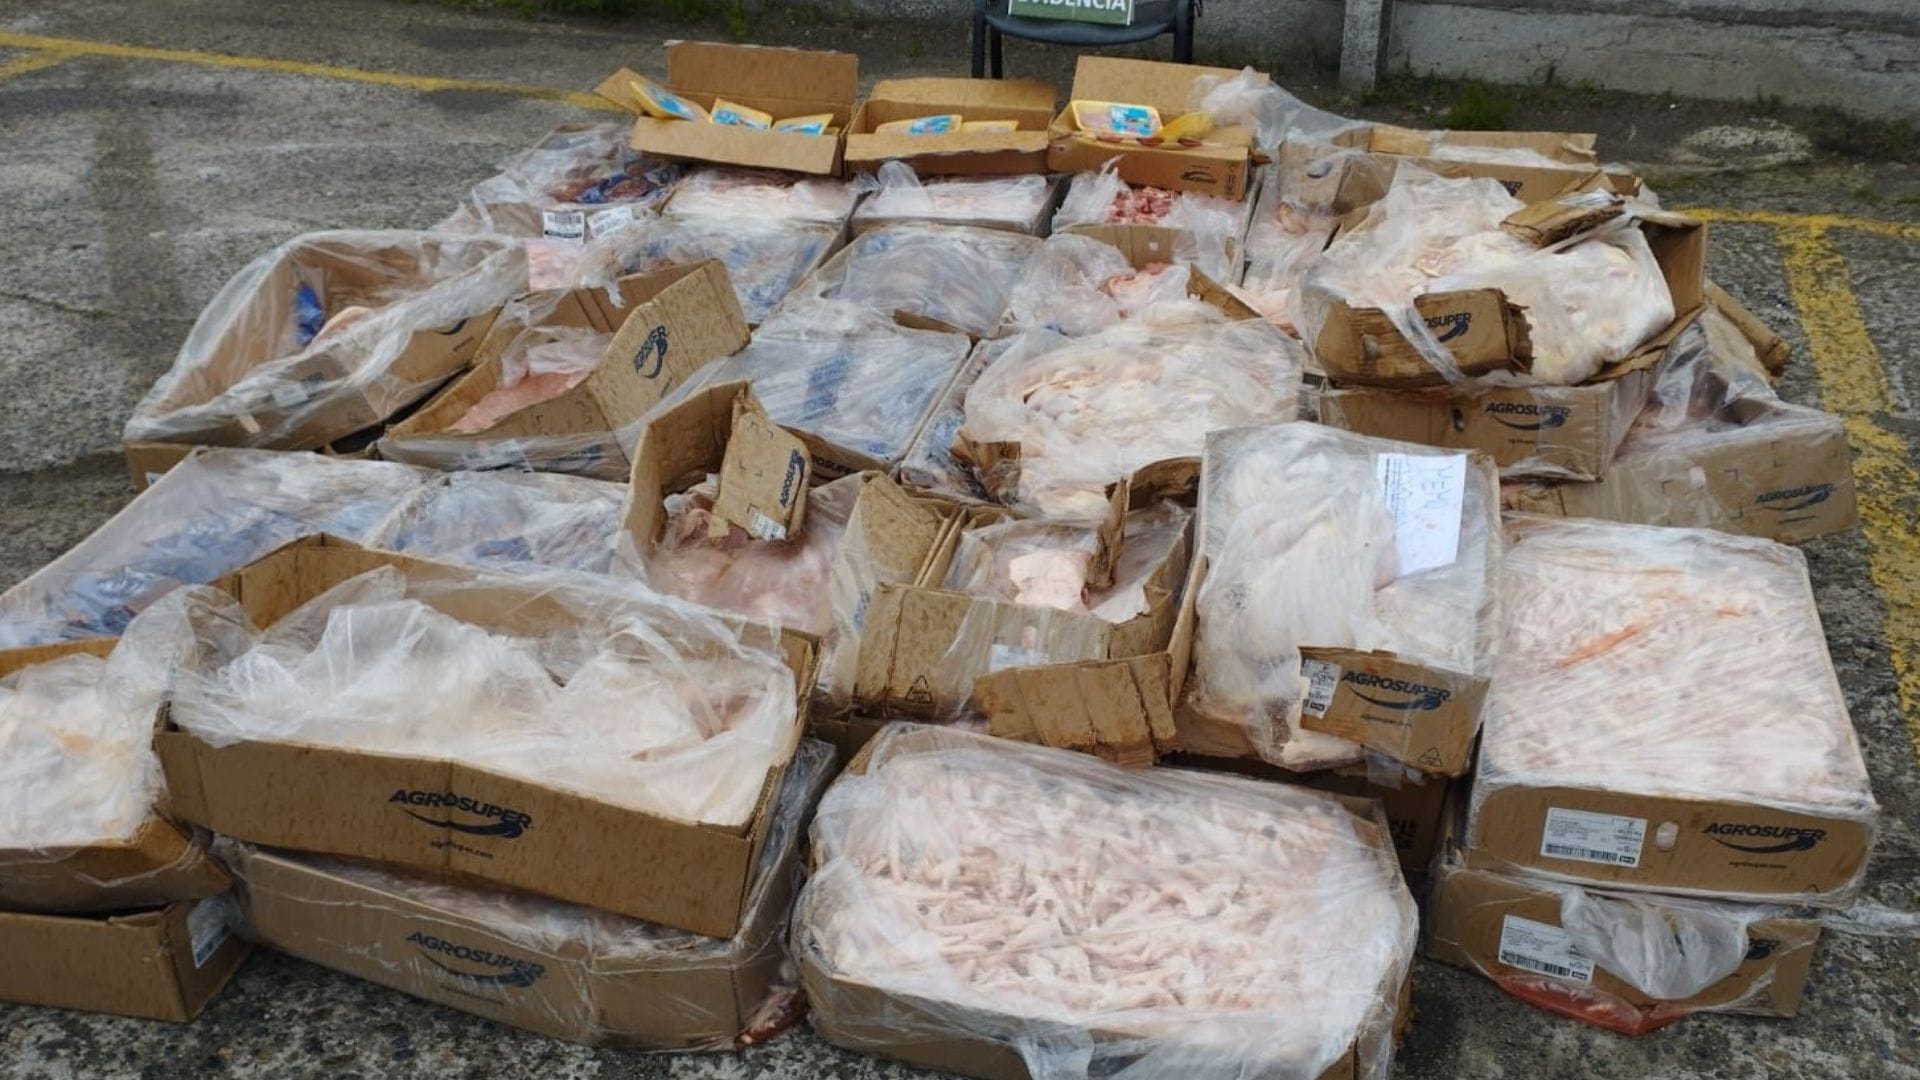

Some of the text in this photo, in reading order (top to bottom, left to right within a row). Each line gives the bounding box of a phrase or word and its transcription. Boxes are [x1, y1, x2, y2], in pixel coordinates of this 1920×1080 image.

[1485, 402, 1571, 418] AGROSUPER
[780, 448, 802, 508] AGROSUPER
[1341, 672, 1451, 701] AGROSUPER
[389, 789, 532, 829] AGROSUPER
[1703, 823, 1827, 841] AGROSUPER
[407, 931, 546, 978] AGROSUPER
